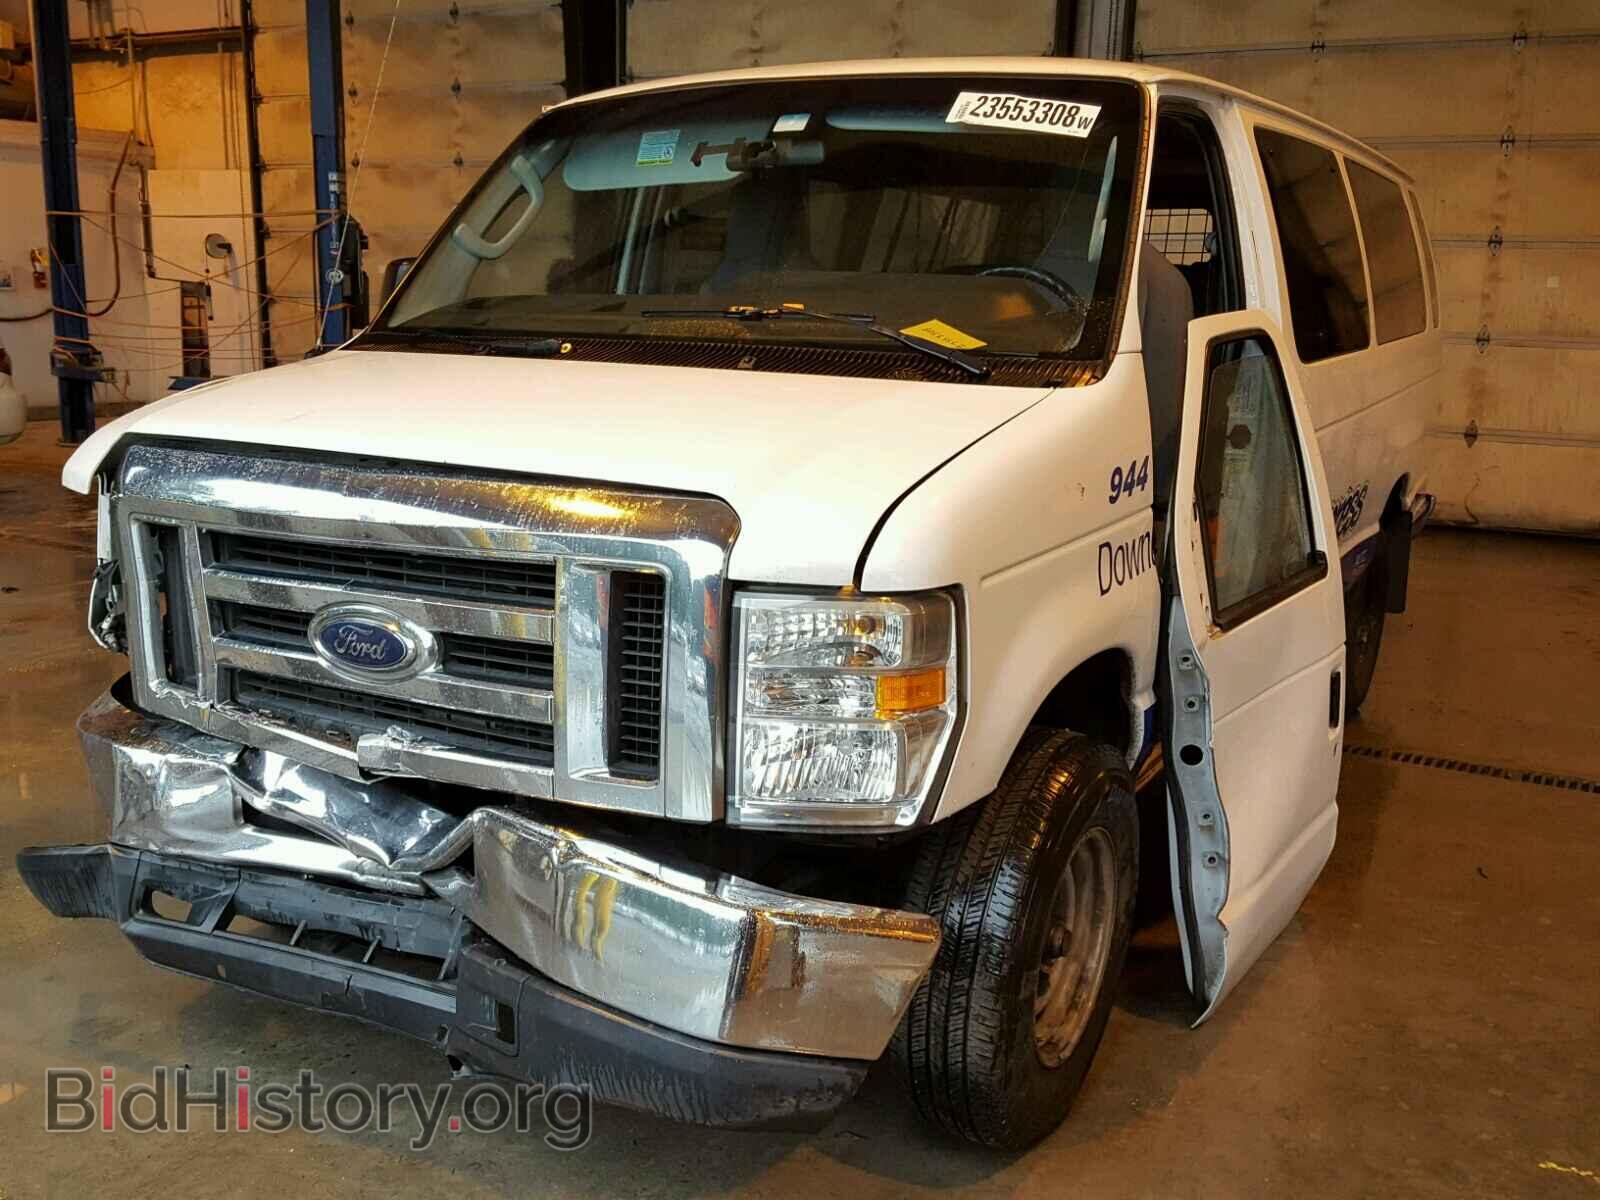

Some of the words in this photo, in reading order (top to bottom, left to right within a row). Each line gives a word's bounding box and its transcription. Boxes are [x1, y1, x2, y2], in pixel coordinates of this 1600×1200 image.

[1108, 455, 1150, 504] 944
[1098, 531, 1152, 596] Down
[334, 624, 386, 660] Ford
